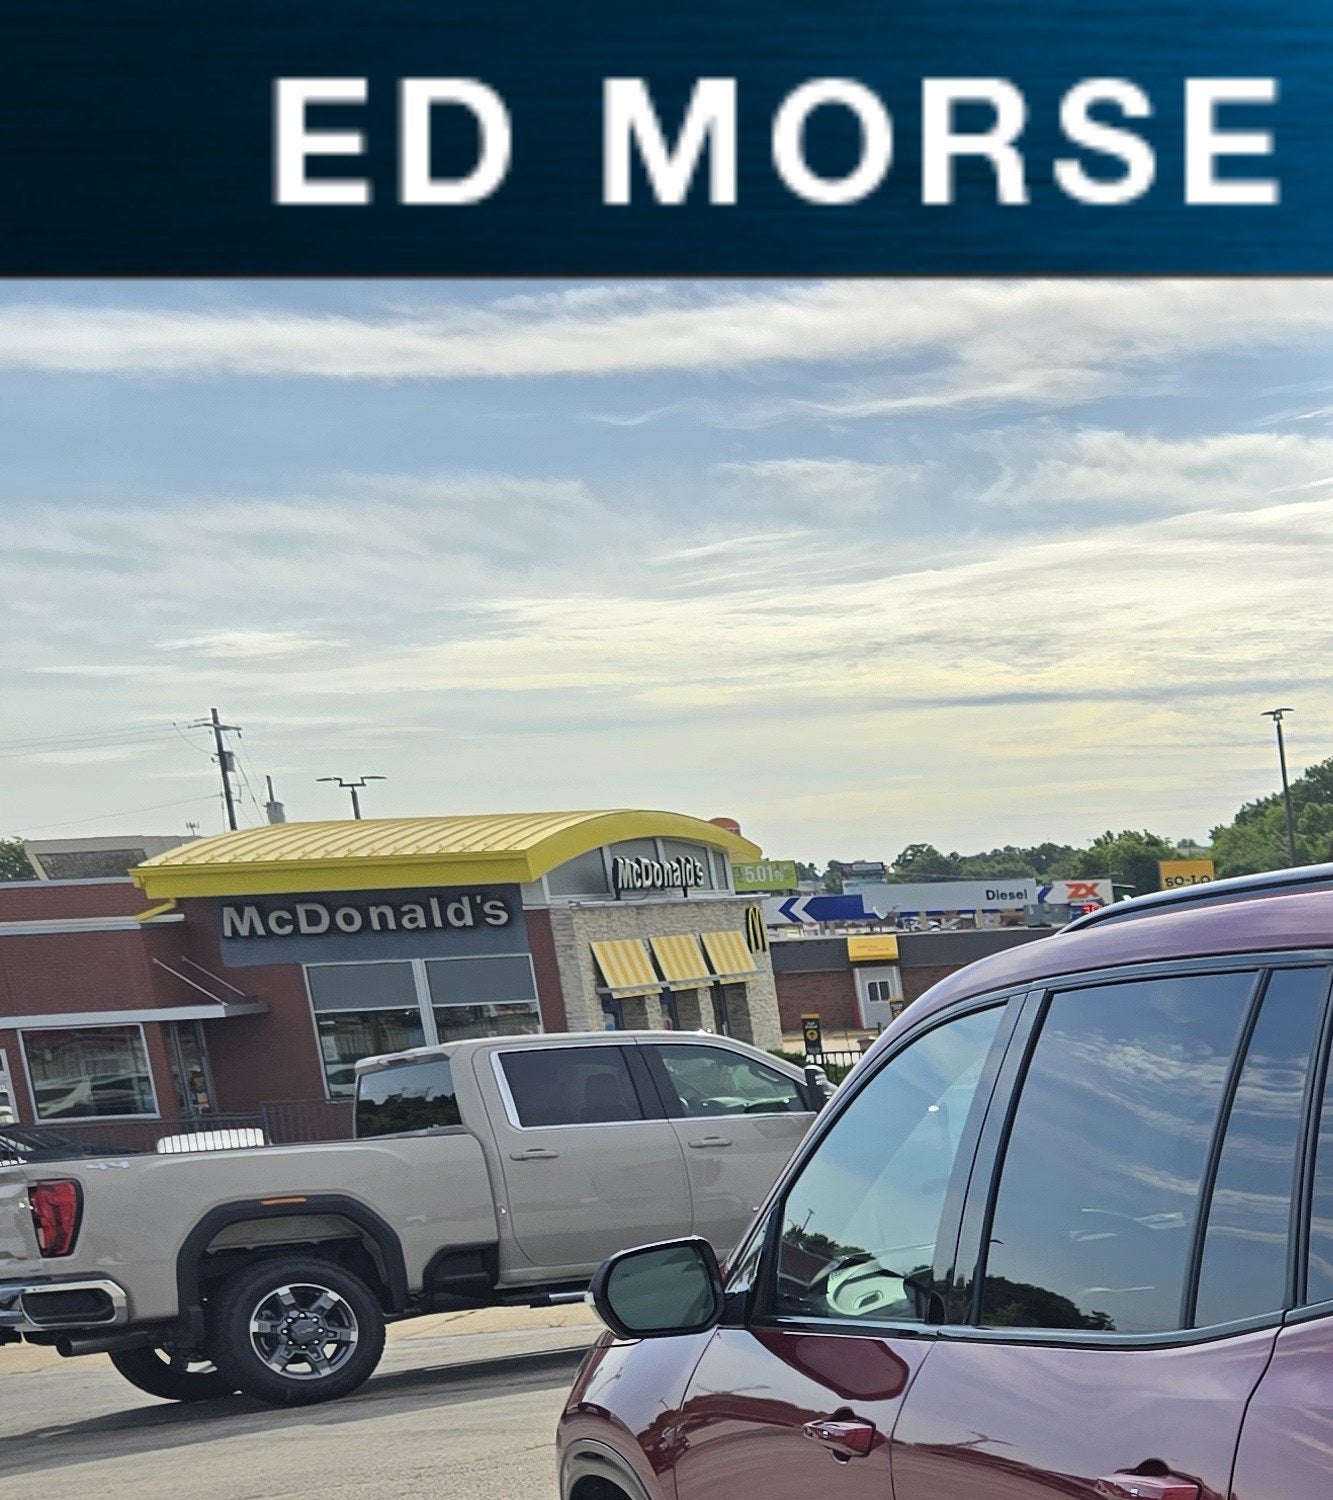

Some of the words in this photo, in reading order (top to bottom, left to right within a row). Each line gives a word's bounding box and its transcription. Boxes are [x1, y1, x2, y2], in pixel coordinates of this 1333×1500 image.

[614, 855, 704, 889] McDonald's
[1164, 875, 1211, 888] SO-LO
[985, 889, 1028, 901] Diesel
[222, 895, 510, 938] McDonald's
